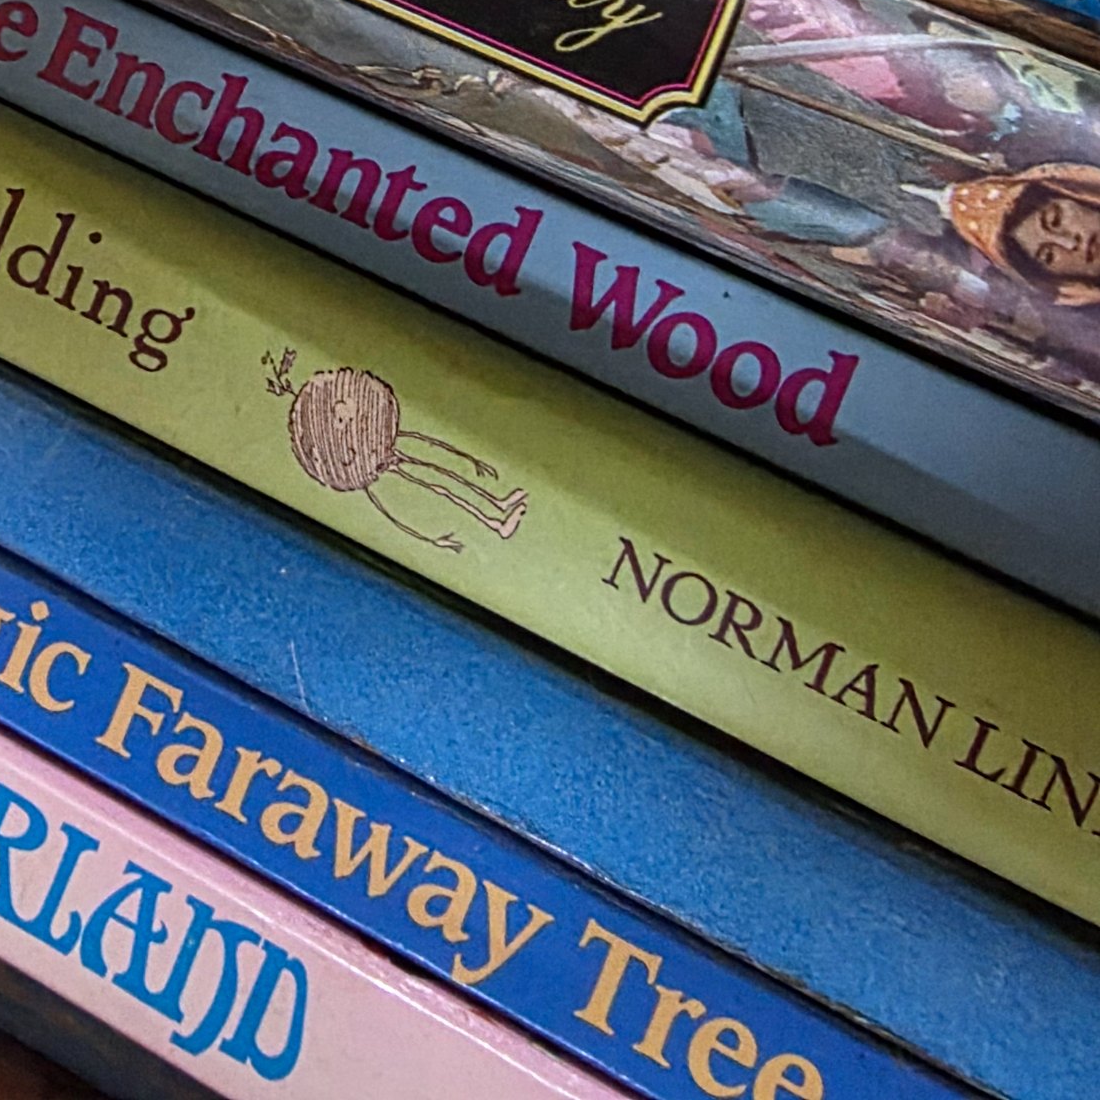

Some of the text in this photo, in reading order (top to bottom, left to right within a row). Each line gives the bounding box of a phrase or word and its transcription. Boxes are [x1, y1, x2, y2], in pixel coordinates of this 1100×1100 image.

[37, 4, 545, 298] Enchanted
[568, 240, 860, 447] Wood
[95, 661, 555, 987] Faraway
[573, 917, 825, 1100] Tree
[602, 537, 1100, 837] NORMAN LIN
